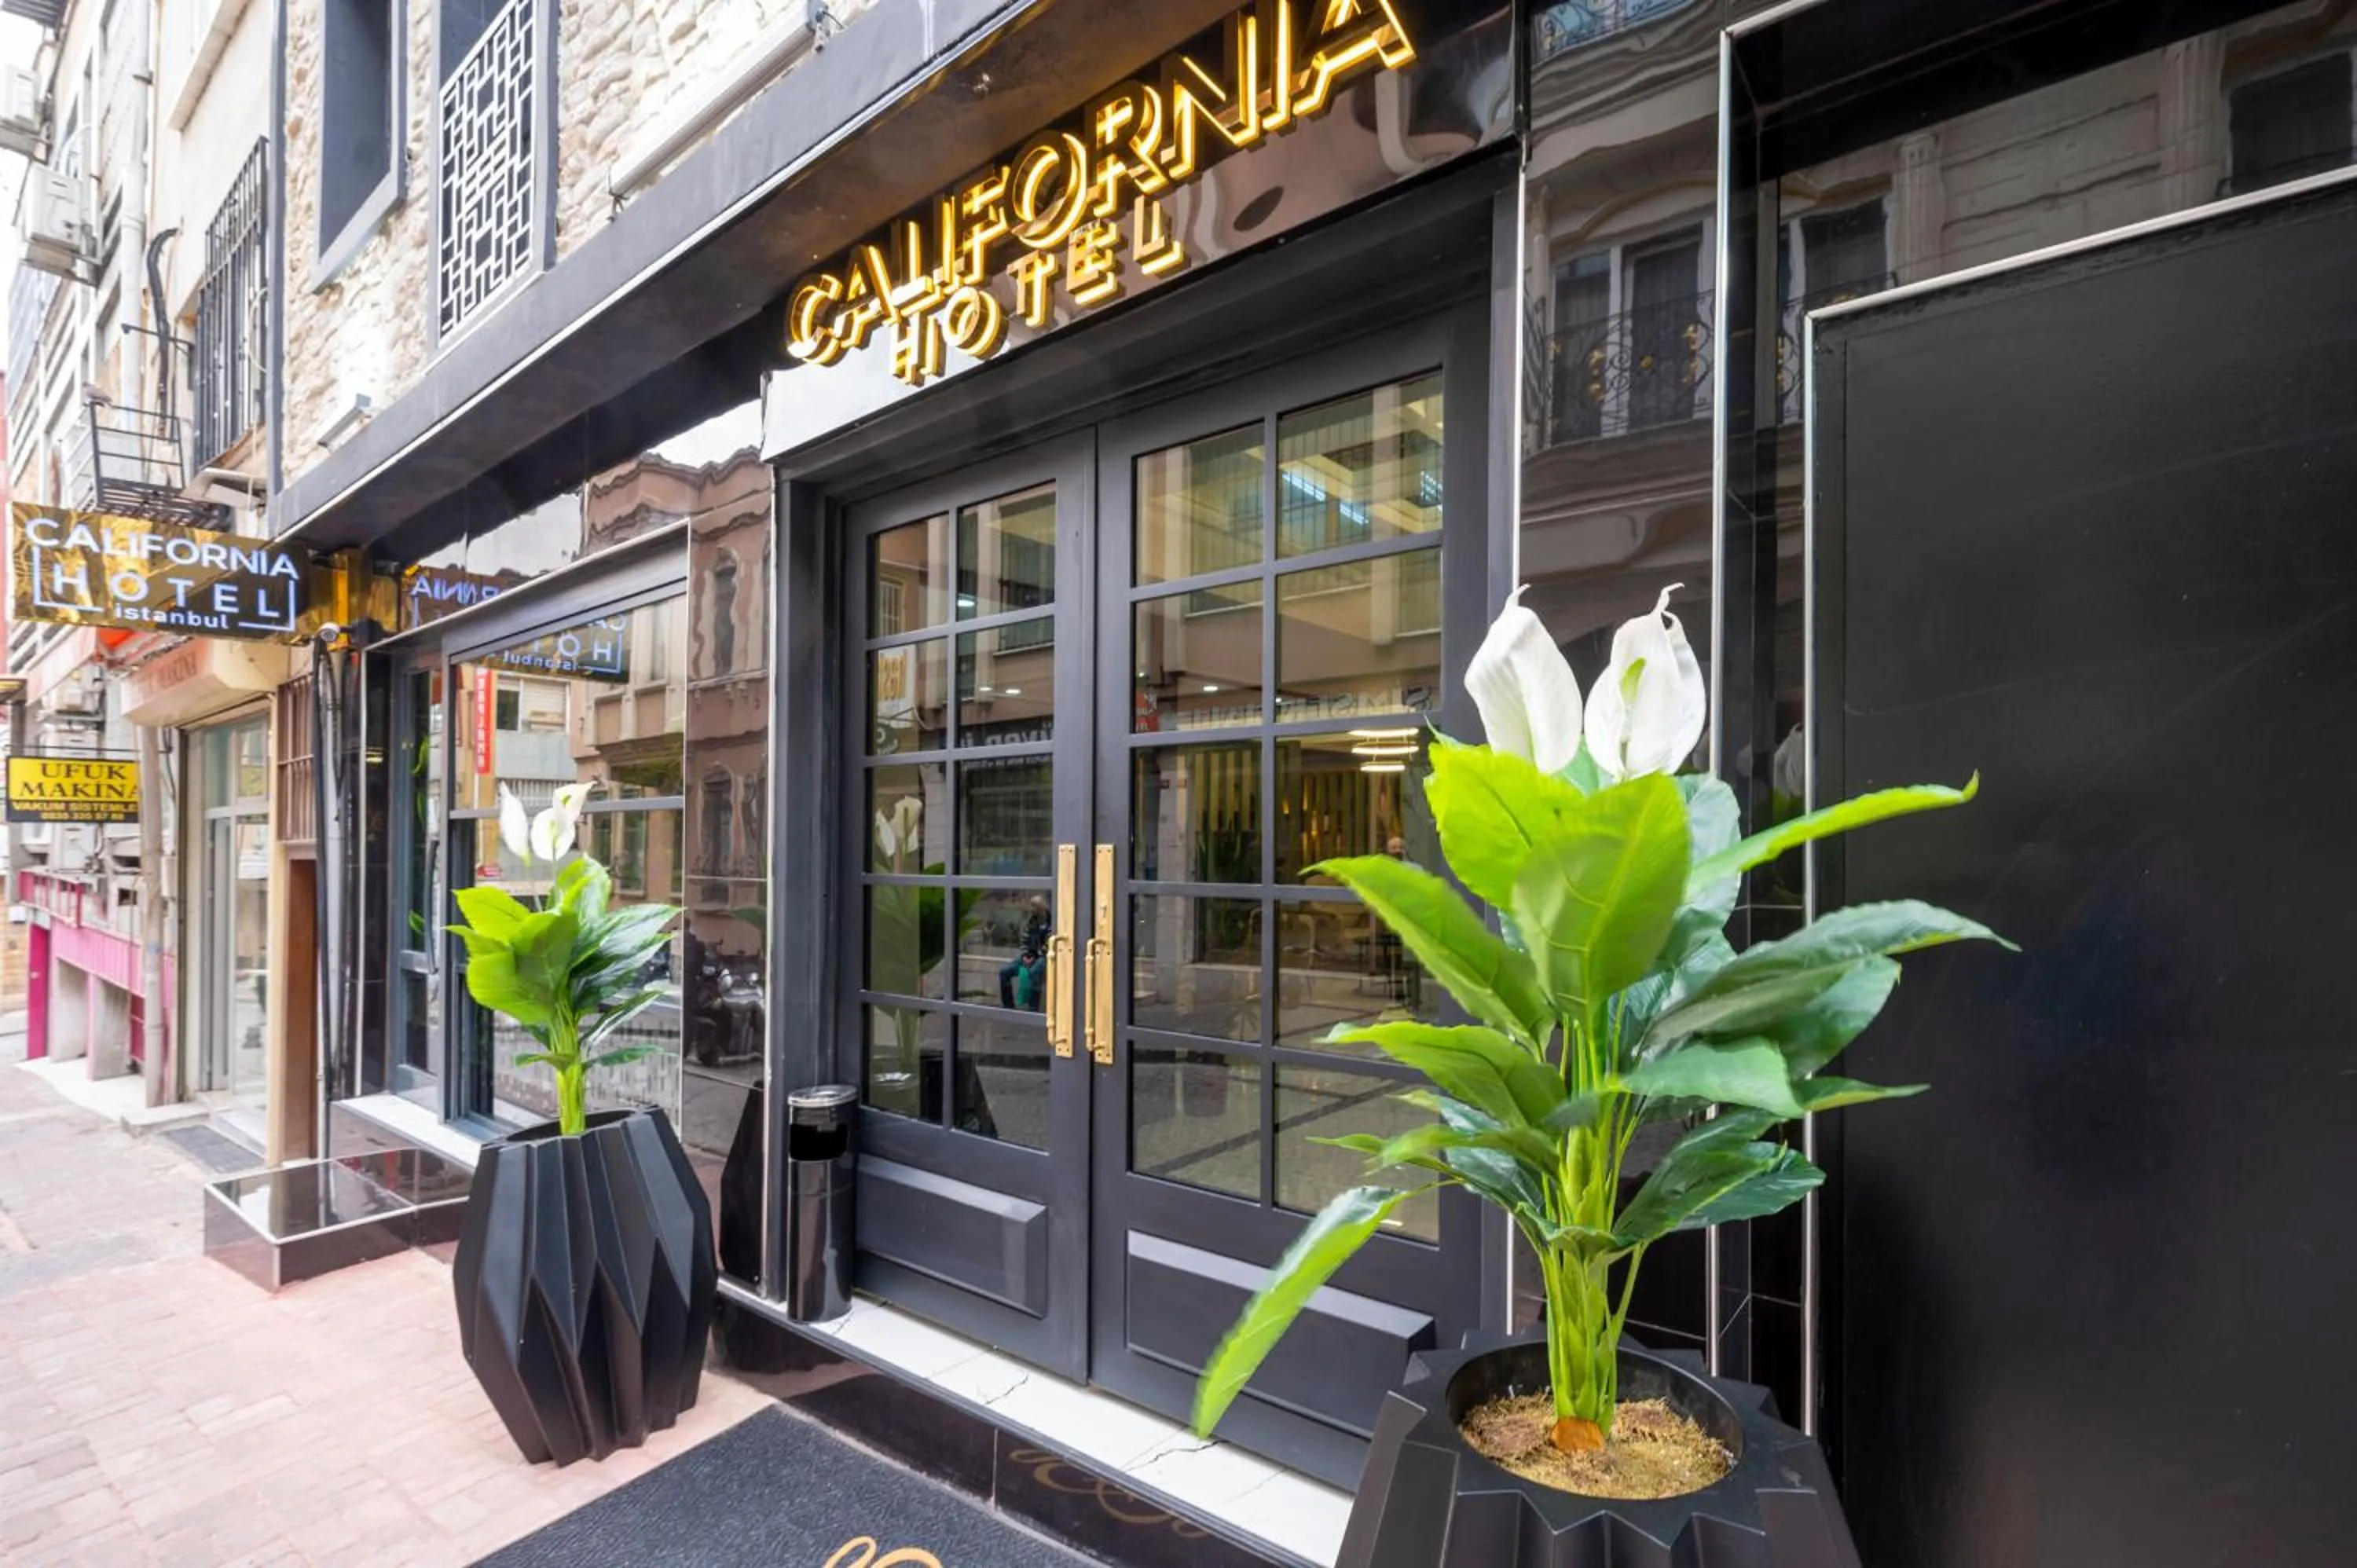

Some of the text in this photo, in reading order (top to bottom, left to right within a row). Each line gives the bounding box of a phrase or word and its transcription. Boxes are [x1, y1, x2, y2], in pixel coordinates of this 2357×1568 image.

[787, 0, 1417, 366] CALIFORNIA
[883, 195, 1185, 387] HOTEL
[25, 517, 300, 580] CALIFORNIA
[53, 563, 280, 618] HOTEL
[114, 603, 229, 630] istanbul
[41, 762, 128, 781] UFUK
